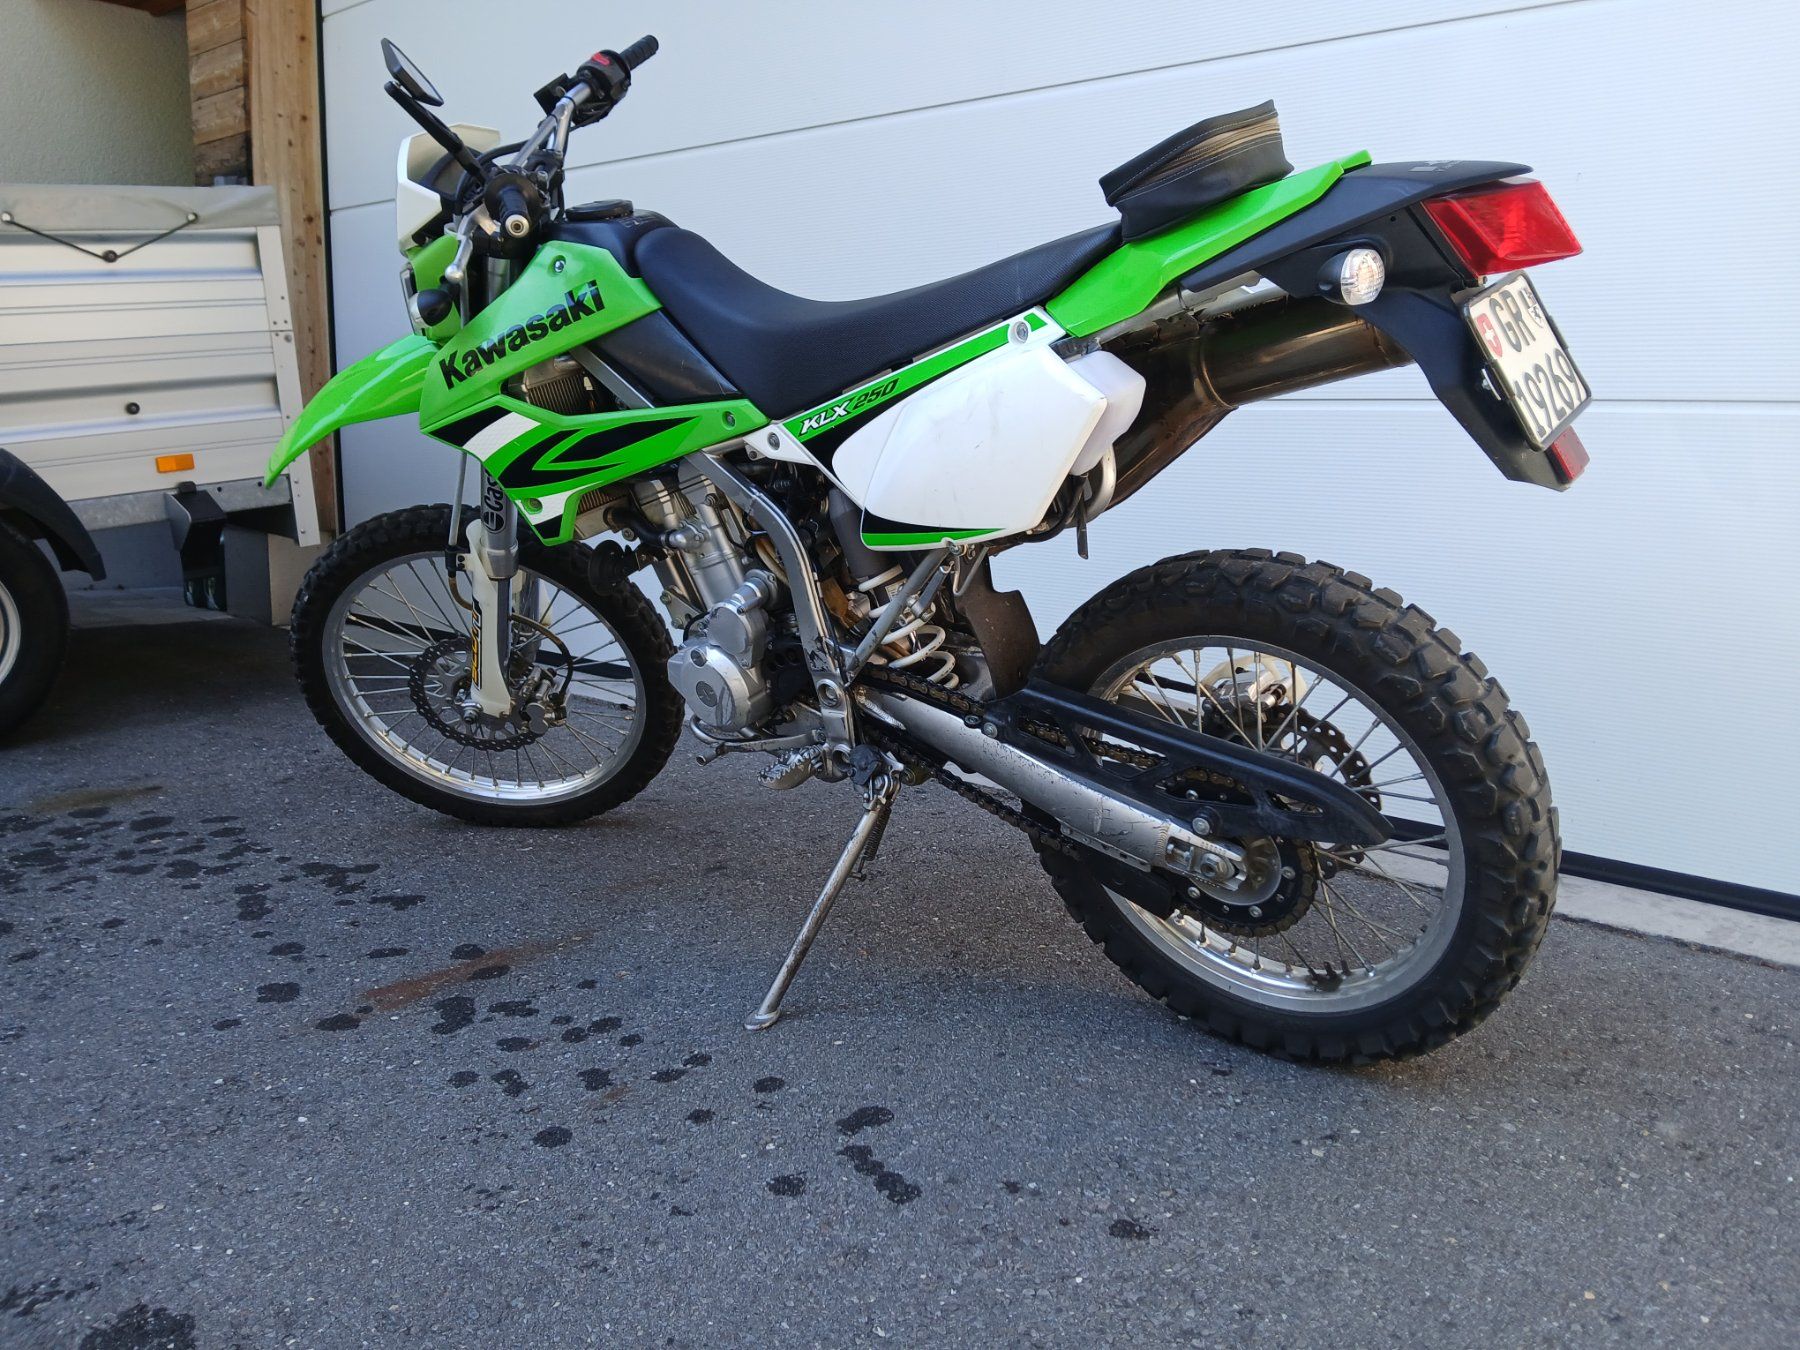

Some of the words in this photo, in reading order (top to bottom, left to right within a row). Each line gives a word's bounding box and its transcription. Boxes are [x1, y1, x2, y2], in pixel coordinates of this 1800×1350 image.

[438, 279, 606, 391] Kawasaki
[1489, 289, 1537, 353] GR
[799, 400, 852, 436] KLX
[852, 378, 900, 411] 250
[1513, 347, 1583, 438] 19269
